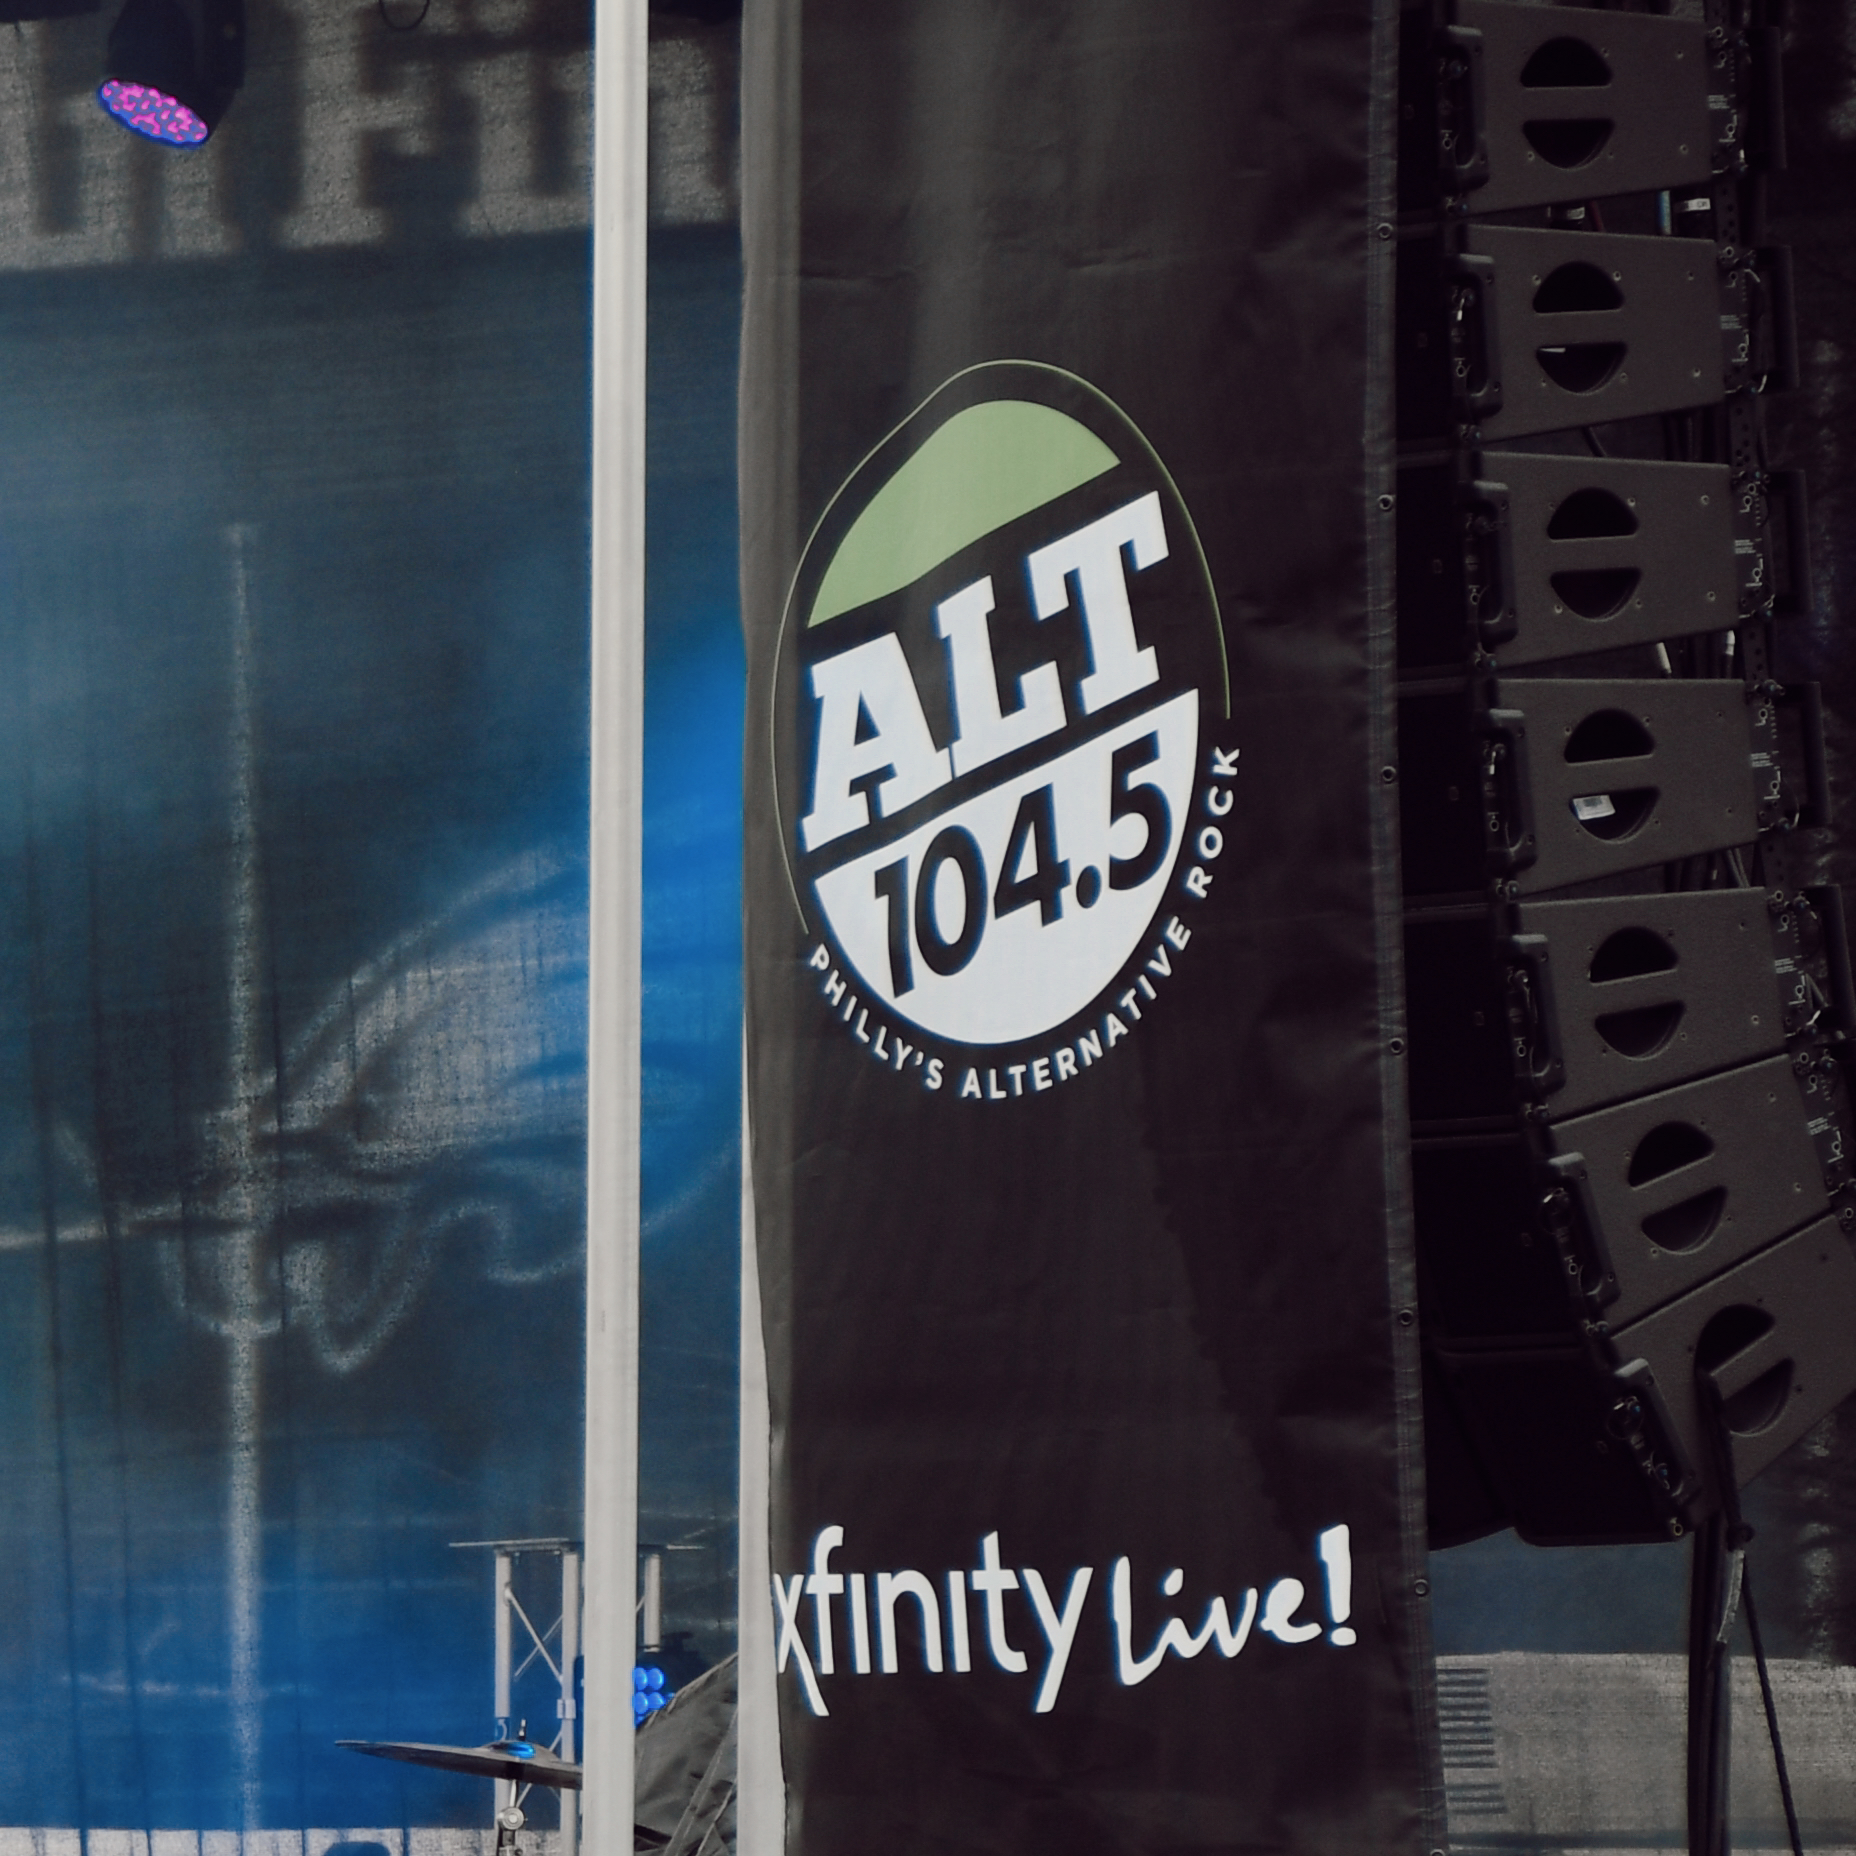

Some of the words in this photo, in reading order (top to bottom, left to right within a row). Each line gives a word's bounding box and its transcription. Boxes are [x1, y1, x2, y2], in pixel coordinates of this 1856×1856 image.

[802, 490, 1170, 853] ALT
[809, 942, 945, 1091] PHILLY'S
[960, 915, 1193, 1101] ALTERNATIVE
[1186, 745, 1242, 900] ROCK
[873, 729, 1174, 999] 104.5
[773, 1524, 1094, 1718] xfinity
